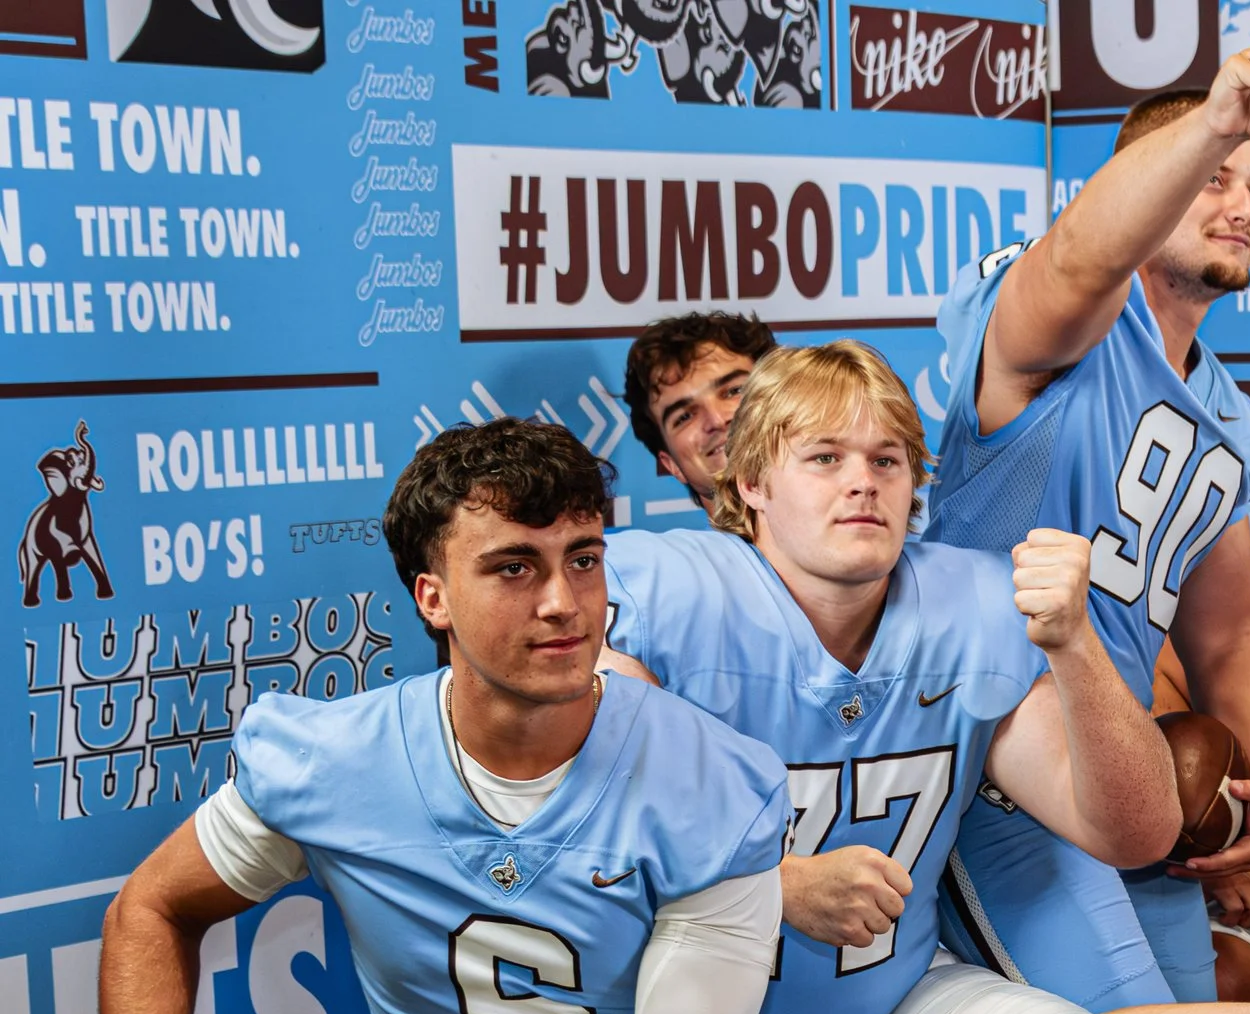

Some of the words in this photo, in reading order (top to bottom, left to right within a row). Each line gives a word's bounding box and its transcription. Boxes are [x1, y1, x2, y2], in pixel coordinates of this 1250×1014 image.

[346, 6, 435, 53] Jumbos
[346, 64, 435, 111] Jumbos
[89, 102, 261, 177] TOWN.
[349, 109, 437, 157] Jumbos
[351, 155, 439, 204] Jumbos
[75, 205, 170, 257] TITLE
[179, 206, 300, 259] TOWN.
[353, 201, 441, 250] Jumbos
[356, 253, 443, 301] Jumbos
[0, 282, 95, 334] TITLE
[105, 281, 231, 333] TOWN.
[358, 299, 444, 347] Jumbos
[136, 421, 384, 494] ROLLLLLLLLL
[289, 518, 382, 553] TUFTS
[1089, 400, 1245, 635] 90
